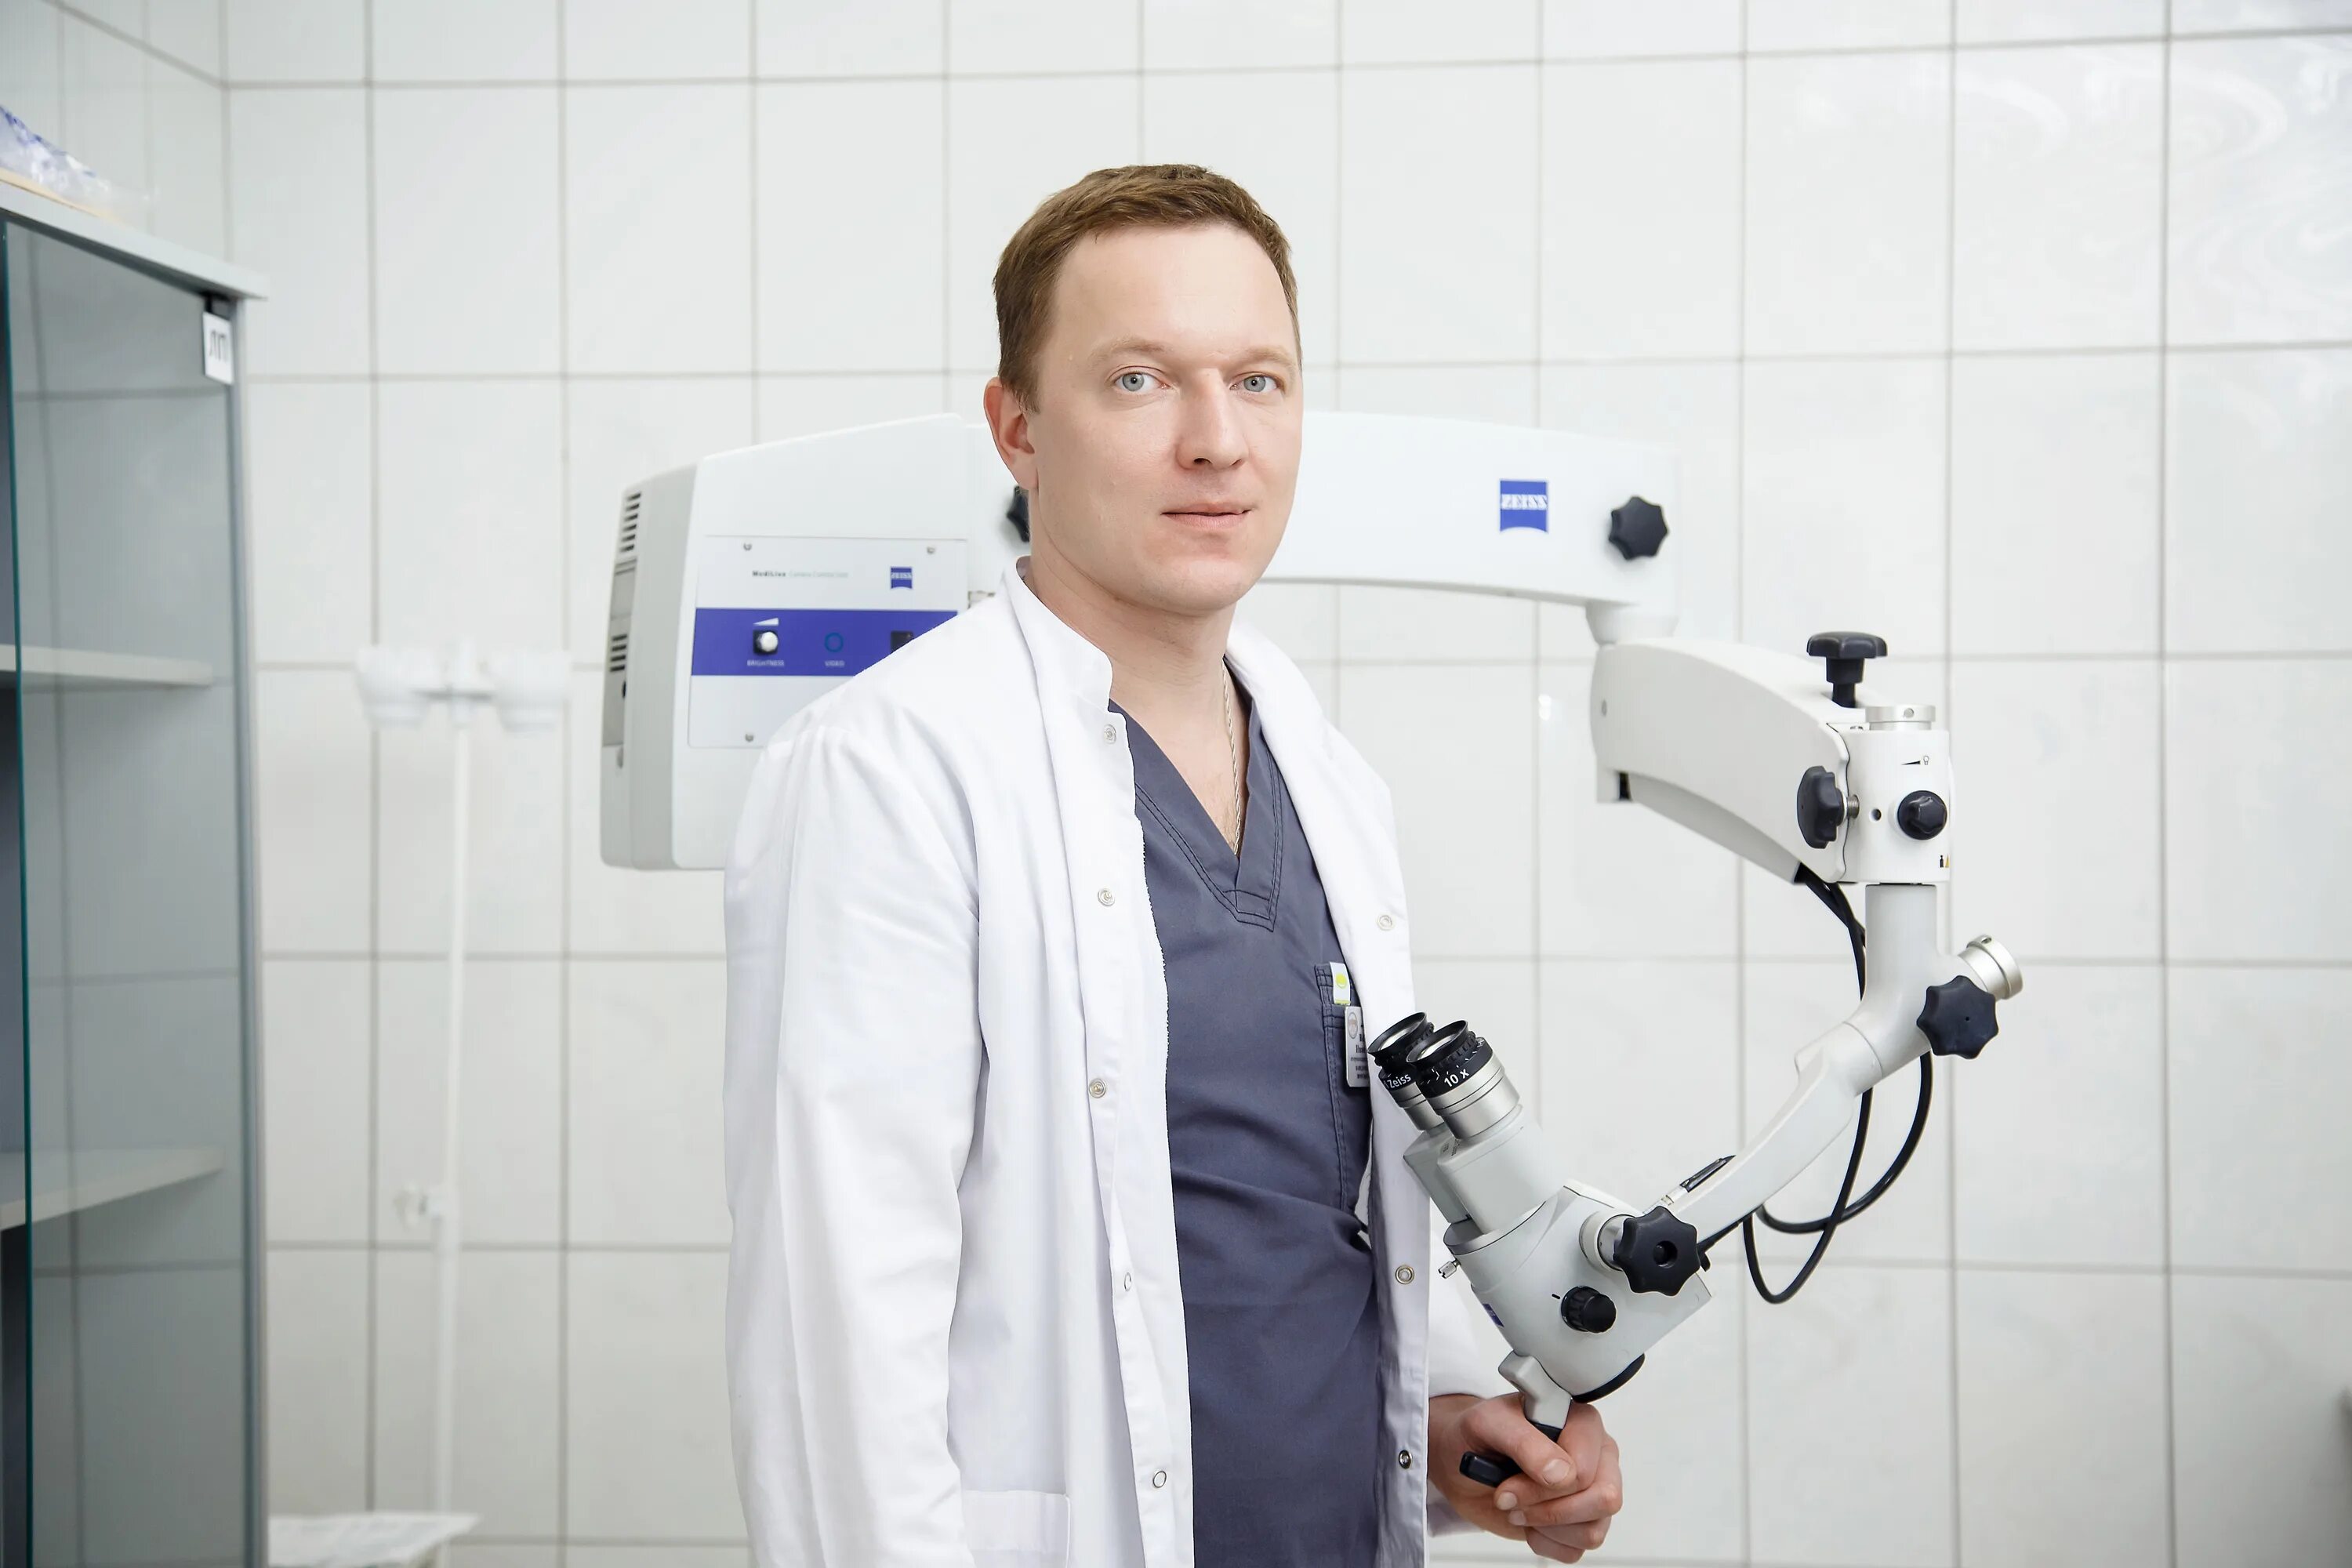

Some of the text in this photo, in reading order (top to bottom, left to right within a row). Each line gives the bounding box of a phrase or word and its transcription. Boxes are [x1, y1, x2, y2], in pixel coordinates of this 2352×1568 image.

[1501, 493, 1548, 511] ZEISS
[1387, 1073, 1412, 1089] Zeiss
[1444, 1073, 1459, 1087] 10
